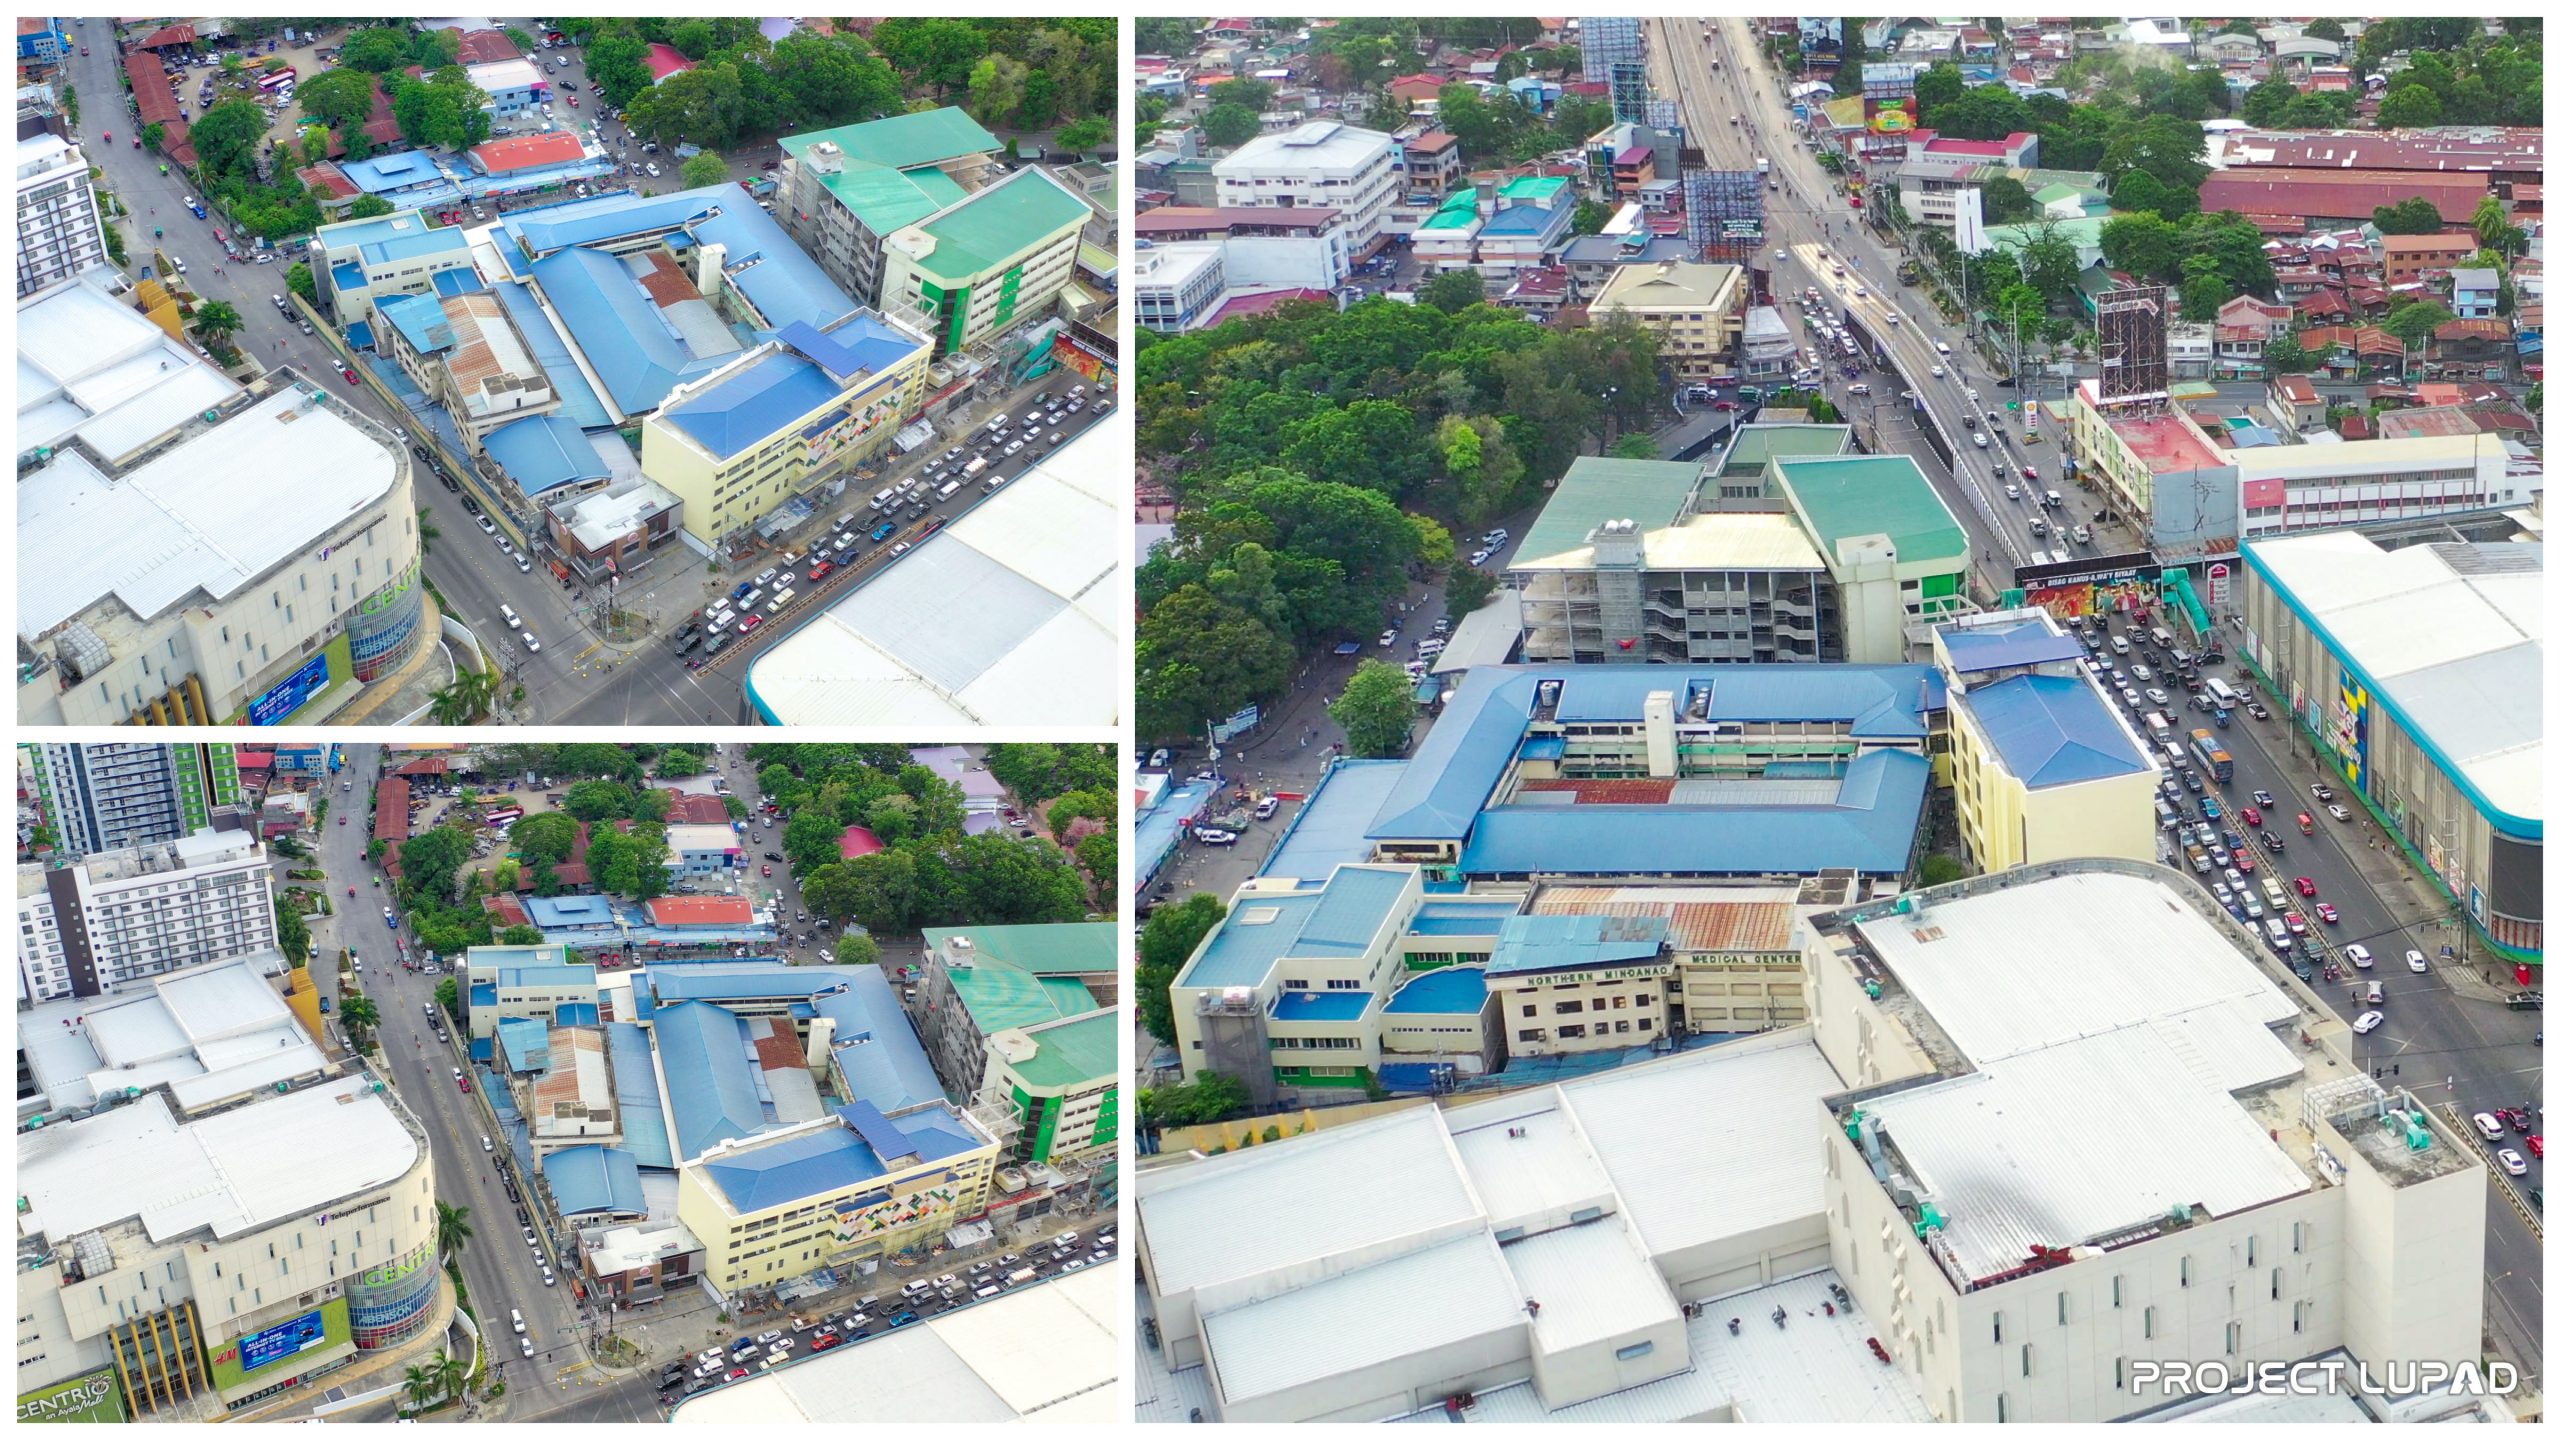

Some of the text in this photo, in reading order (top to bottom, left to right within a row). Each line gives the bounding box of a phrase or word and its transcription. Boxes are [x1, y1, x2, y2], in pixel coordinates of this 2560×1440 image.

[333, 513, 388, 552] Teleperformance
[1692, 955, 1801, 964] MEDICAL CENTER
[1527, 966, 1667, 986] NORTHERN MINDANAO
[331, 1196, 391, 1221] Teleperformance
[360, 1303, 412, 1323] ABENSON
[247, 1331, 283, 1348] ALL-IN-ONE
[17, 1381, 110, 1420] CENTRIO
[45, 1395, 104, 1421] an Ayala Mall
